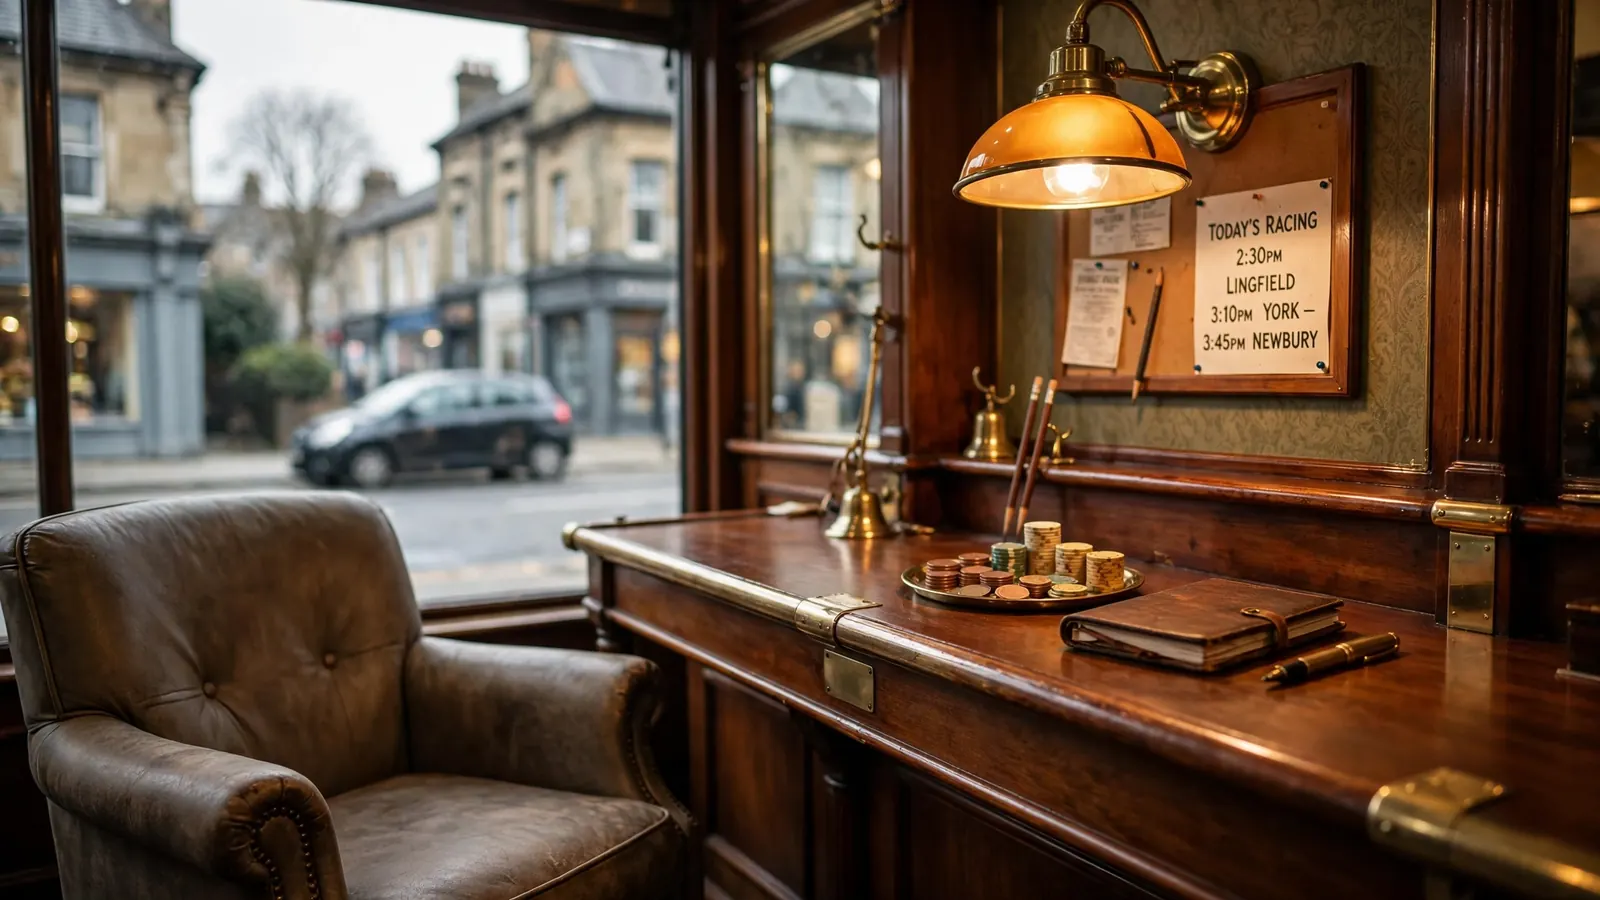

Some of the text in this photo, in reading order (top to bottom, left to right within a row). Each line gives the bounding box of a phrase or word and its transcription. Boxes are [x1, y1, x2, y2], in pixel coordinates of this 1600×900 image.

[1208, 211, 1318, 241] TODAY'S RACING
[1236, 246, 1282, 266] 2:30PM
[1226, 273, 1295, 295] LINGFIELD
[1211, 304, 1253, 324] 3:10PM
[1263, 301, 1300, 321] YORK
[1203, 330, 1319, 351] 3:45PM NEWBURY
